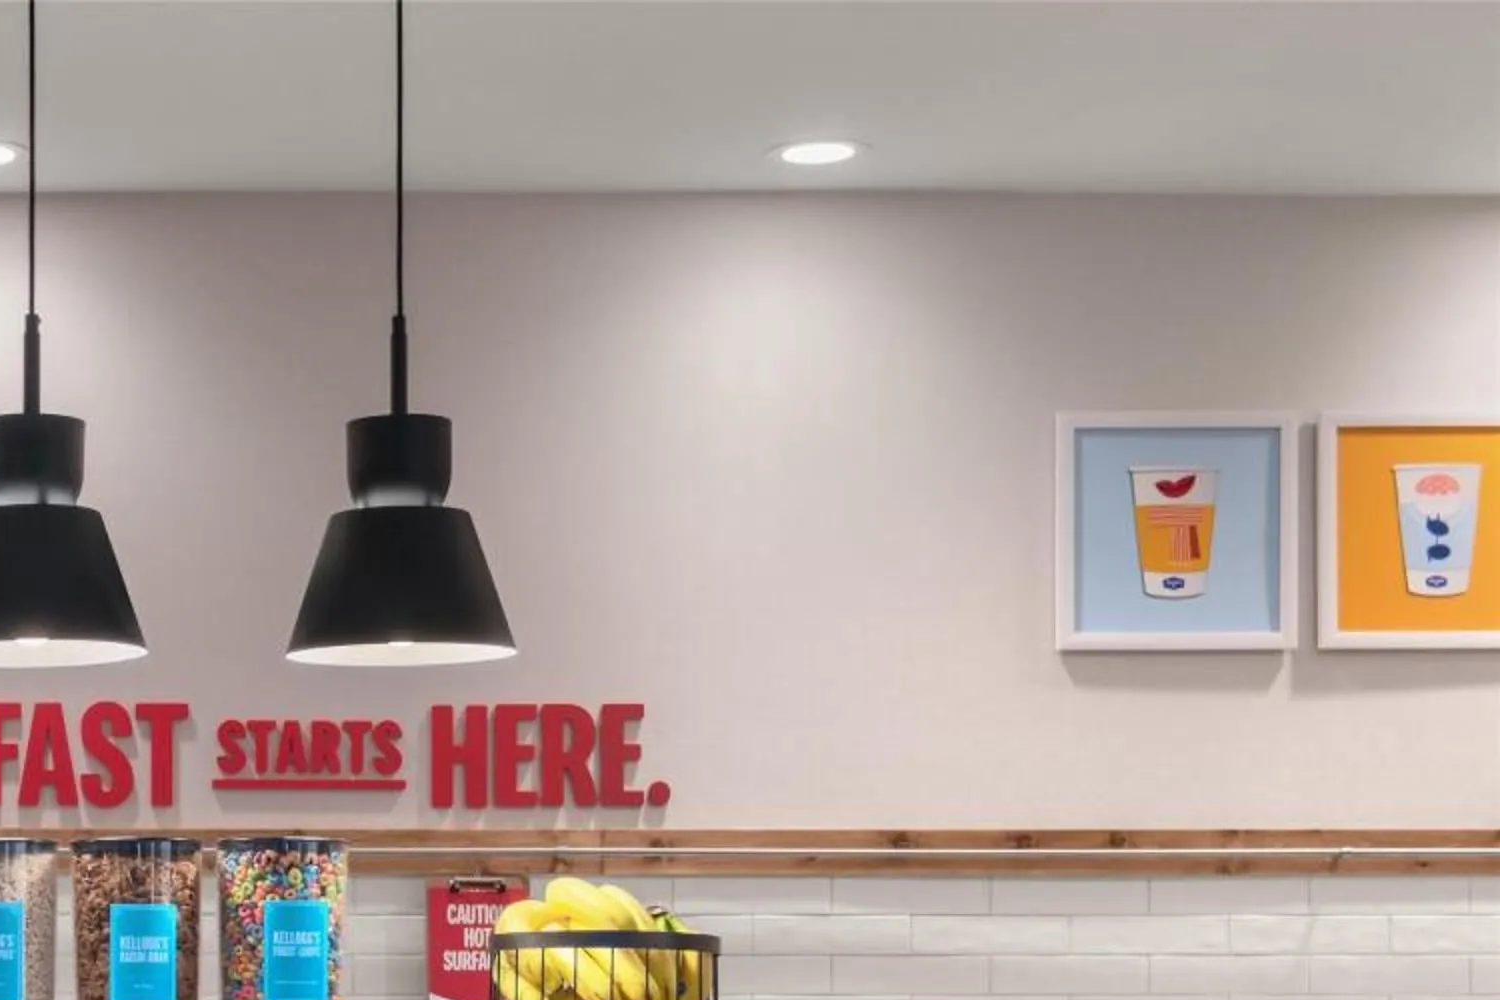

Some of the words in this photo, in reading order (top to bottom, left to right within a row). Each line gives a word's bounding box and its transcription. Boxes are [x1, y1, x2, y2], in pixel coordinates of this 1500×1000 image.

[216, 719, 403, 776] STARTS
[430, 703, 670, 808] HERE.
[446, 903, 504, 925] CAUTIO
[463, 927, 493, 949] HOT
[443, 950, 491, 971] SURFA
